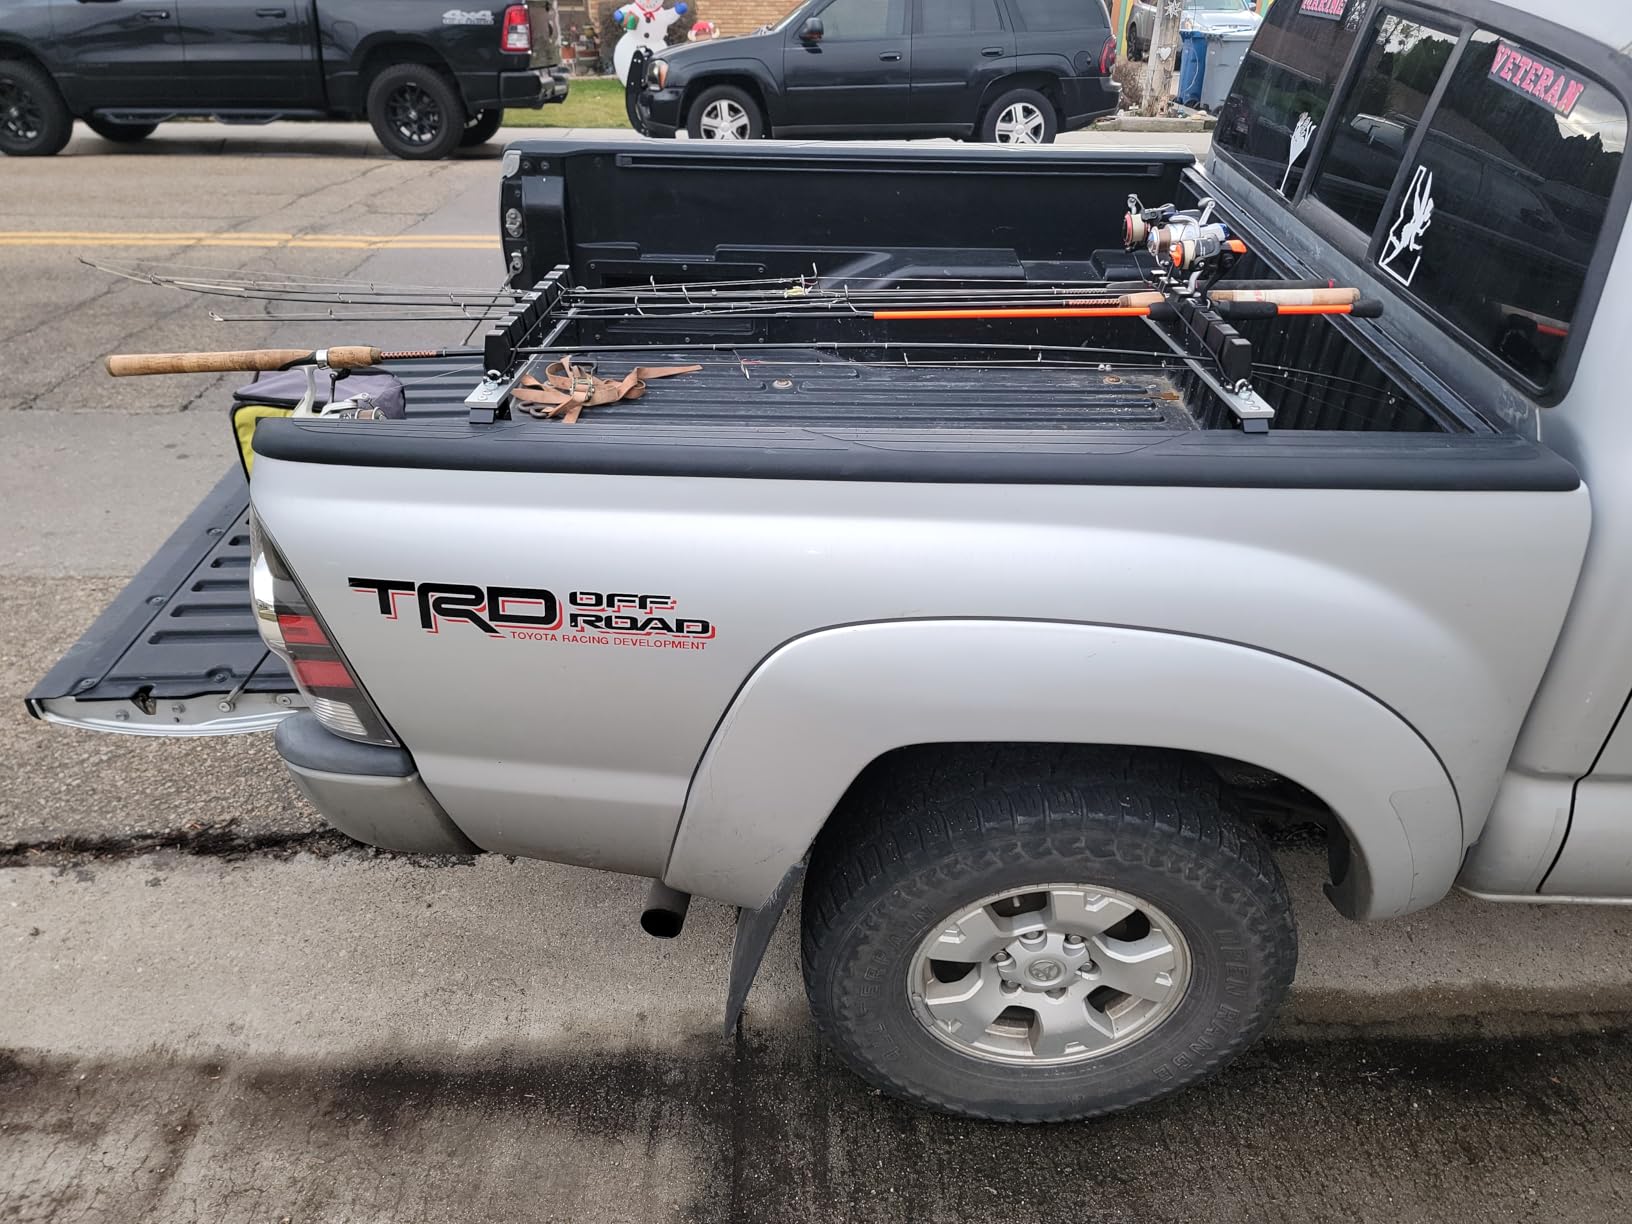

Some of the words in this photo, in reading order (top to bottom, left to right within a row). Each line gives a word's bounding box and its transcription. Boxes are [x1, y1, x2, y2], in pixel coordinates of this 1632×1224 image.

[1491, 45, 1584, 114] VETERAN
[348, 577, 563, 639] TRD
[569, 591, 677, 613] OFF
[569, 612, 716, 640] ROAD
[511, 630, 558, 643] TOYOTA
[562, 634, 609, 645] RACING
[613, 637, 708, 651] DEVELOPMENT
